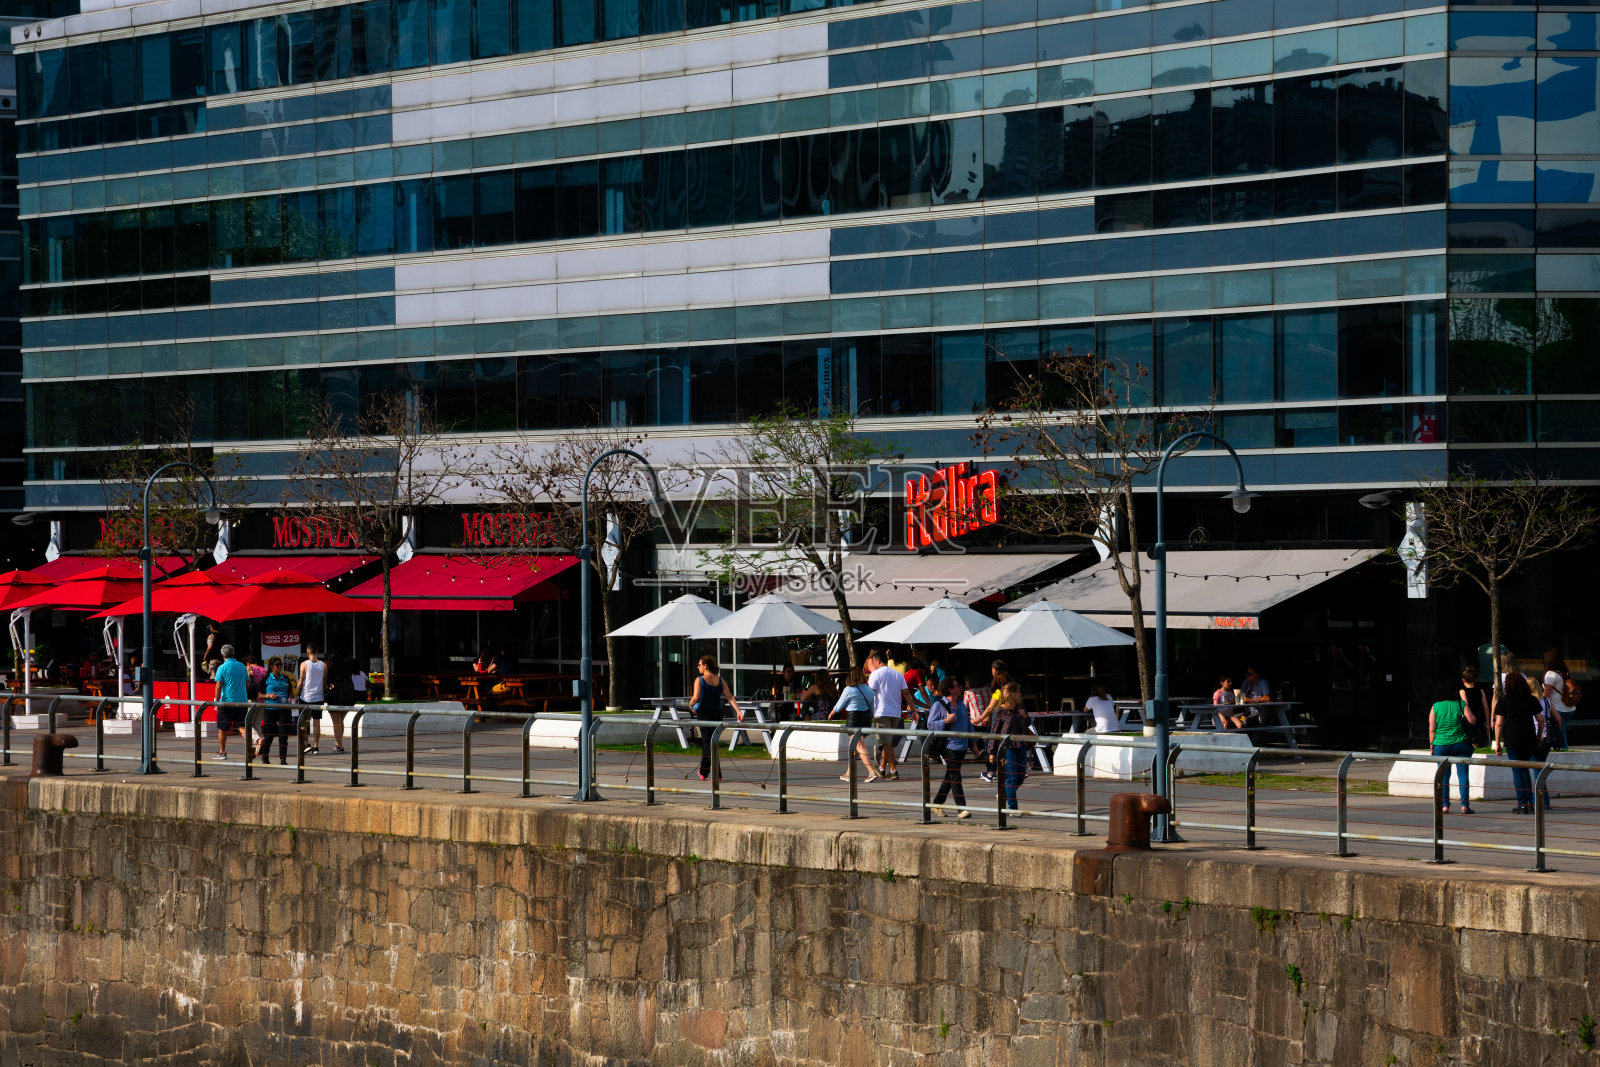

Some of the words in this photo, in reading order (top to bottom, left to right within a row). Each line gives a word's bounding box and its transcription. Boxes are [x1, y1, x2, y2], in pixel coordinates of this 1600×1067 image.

[99, 518, 178, 548] MOSTZA
[272, 516, 359, 547] MOSTAZA
[461, 512, 558, 546] MOSTAZA
